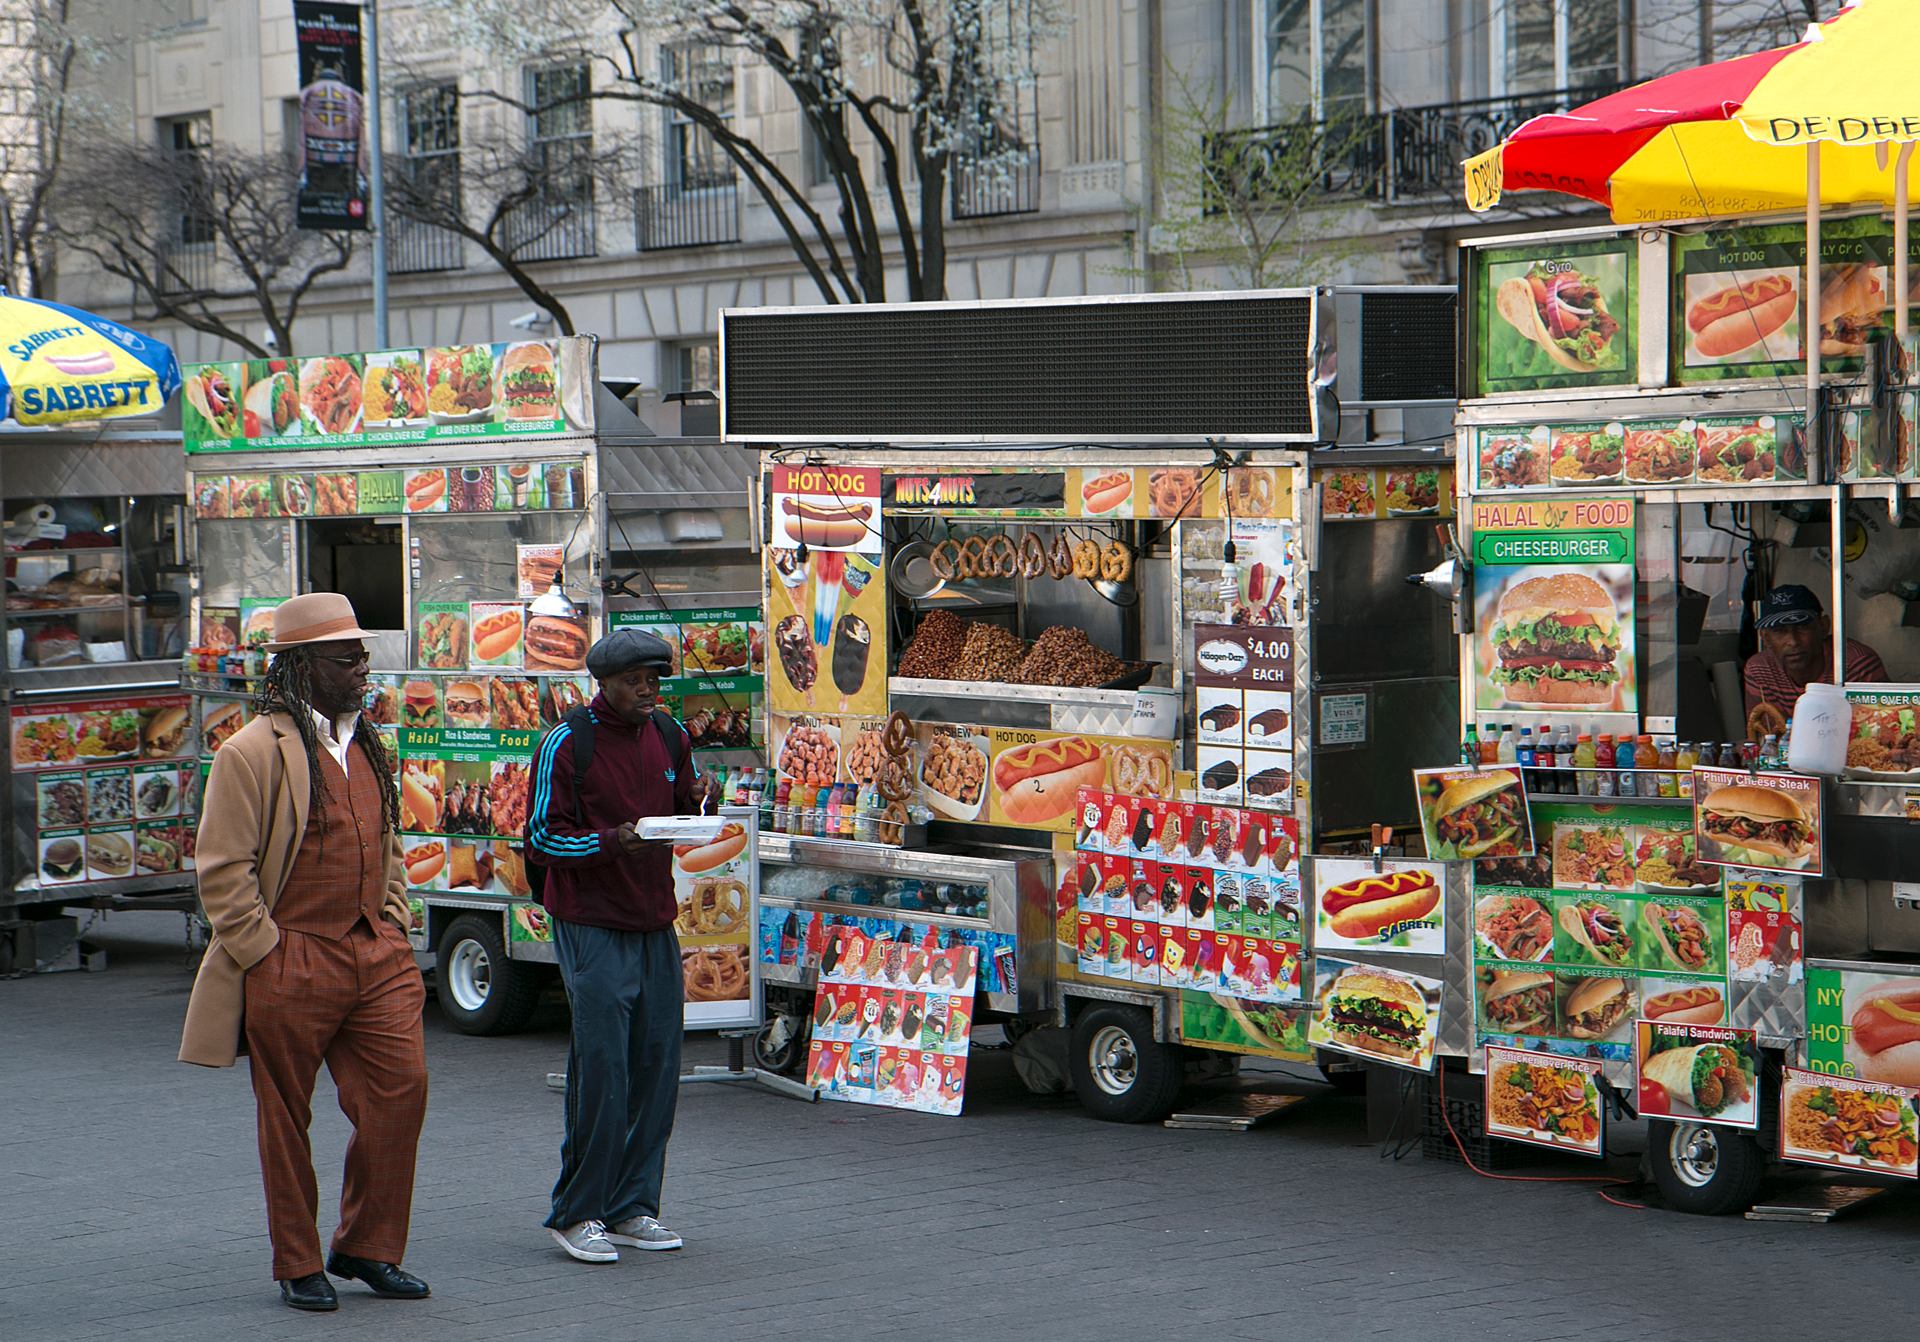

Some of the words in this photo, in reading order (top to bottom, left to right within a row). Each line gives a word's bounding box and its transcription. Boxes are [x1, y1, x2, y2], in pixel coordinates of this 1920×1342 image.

[1719, 253, 1739, 264] HOT
[1743, 251, 1765, 262] DOG
[1545, 260, 1573, 273] Gyro
[8, 327, 85, 361] SABRETT
[23, 381, 150, 415] SABRETT
[436, 426, 452, 435] LAMB
[454, 425, 469, 434] OVER
[471, 424, 485, 433] RICE
[504, 421, 555, 432] CHEESEBURGER
[787, 472, 823, 490] HOT
[826, 473, 865, 493] DOG
[1477, 506, 1538, 528] HALAL
[1575, 504, 1629, 525] FOOD
[1494, 540, 1610, 557] CHEESEBURGER
[620, 613, 645, 622] Chicken
[692, 611, 708, 619] Lamb
[1248, 637, 1289, 659] $4.00
[1252, 668, 1284, 682] EACH
[1848, 695, 1877, 704] LAMB
[1881, 695, 1909, 704] OVER
[408, 732, 439, 744] Halal
[934, 727, 970, 738] CASHEW
[996, 732, 1015, 743] HOT
[1016, 733, 1037, 743] DOG
[500, 734, 529, 746] Food
[1033, 779, 1045, 793] 2
[1703, 772, 1733, 786] Philly
[1736, 775, 1776, 788] Cheese
[1779, 778, 1810, 790] Steak
[1572, 892, 1592, 901] LAMB
[1594, 893, 1615, 902] GYRO
[1650, 896, 1686, 905] CHICKEN
[1687, 898, 1708, 907] GYRO
[1378, 920, 1436, 942] SABRETT
[1511, 964, 1545, 973] SAUSAGE
[1556, 968, 1580, 976] PHILLY
[1582, 968, 1612, 977] CHEESE
[1614, 969, 1638, 979] STEAK
[1818, 988, 1845, 1006] NY
[1657, 1025, 1687, 1037] Falafel
[1689, 1028, 1736, 1040] Sandwich
[1811, 1023, 1853, 1044] HOT
[1500, 1051, 1540, 1066] Chicken
[1542, 1058, 1565, 1069] over
[1566, 1061, 1590, 1074] Rice
[1811, 1059, 1855, 1079] DOG
[1798, 1072, 1847, 1091] Chicken
[1847, 1083, 1879, 1094] over
[1880, 1084, 1907, 1097] Rice
